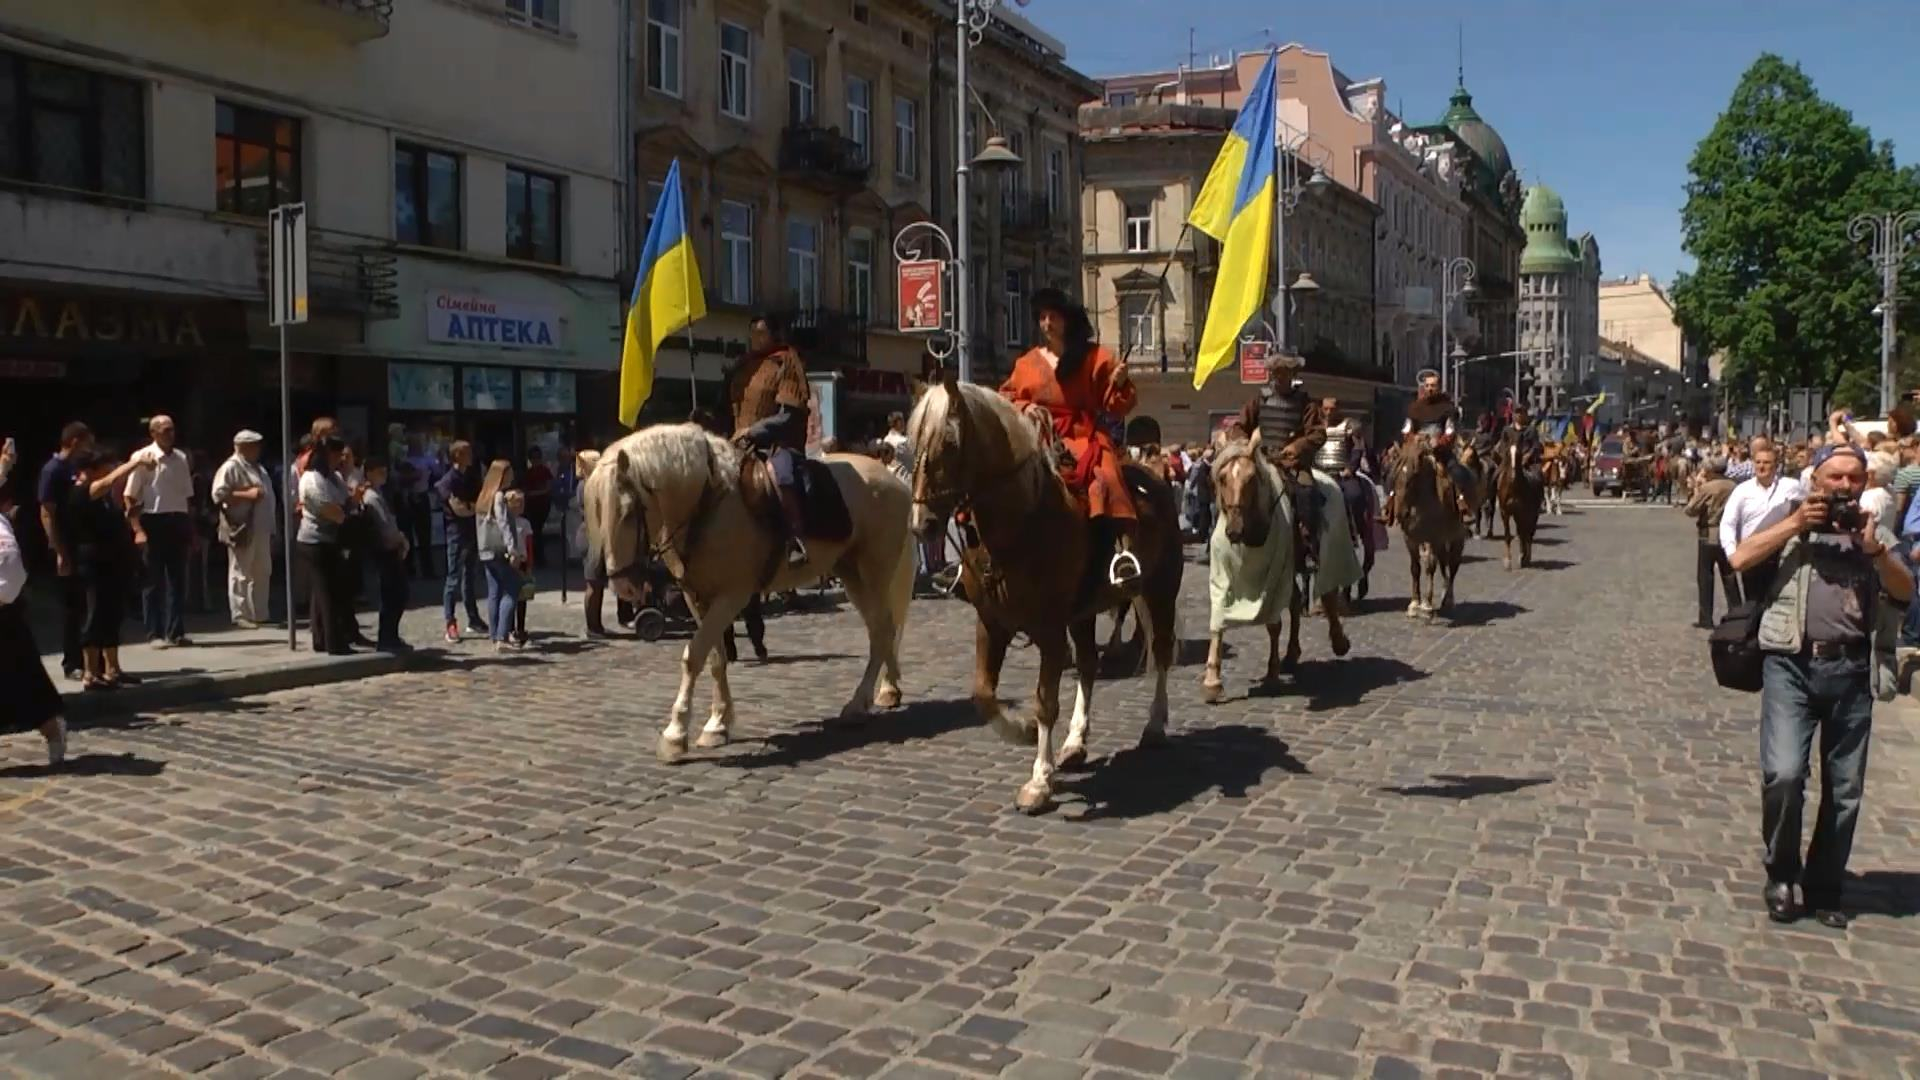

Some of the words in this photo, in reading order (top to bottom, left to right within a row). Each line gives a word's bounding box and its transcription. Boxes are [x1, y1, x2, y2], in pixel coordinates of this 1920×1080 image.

[436, 295, 496, 314] Сімейна
[0, 297, 205, 346] ЛАЗМА
[447, 313, 553, 345] АПТЕКА
